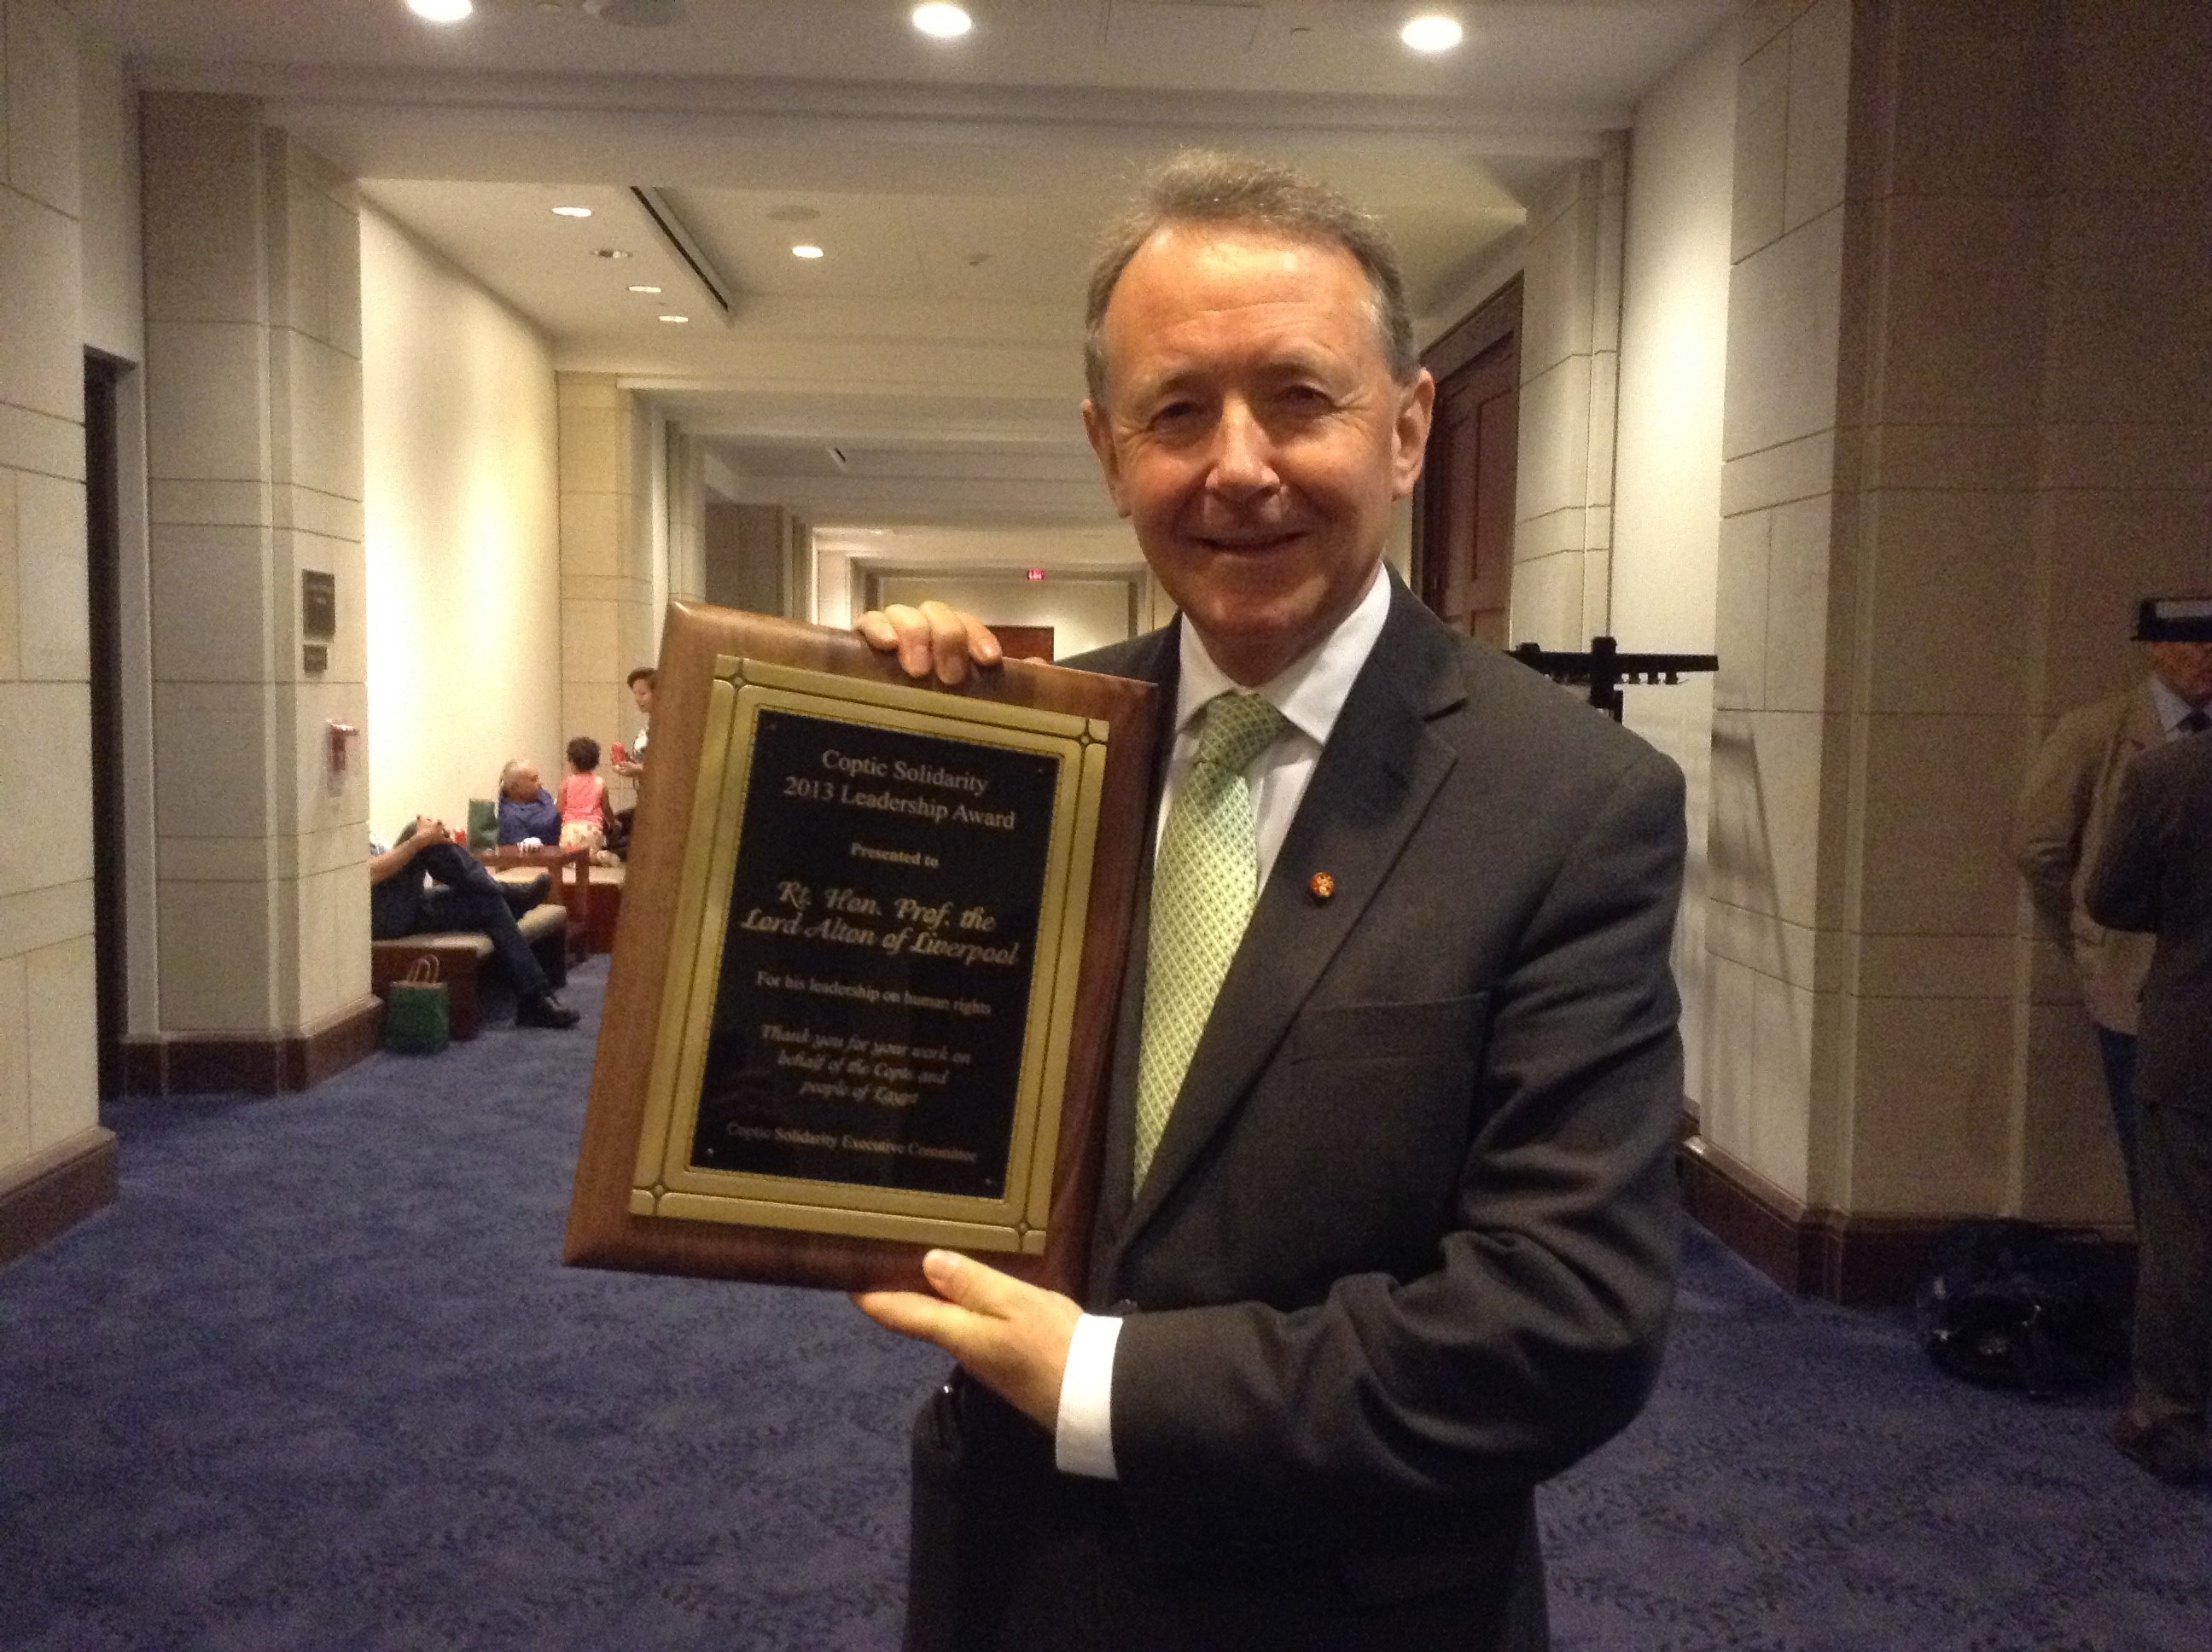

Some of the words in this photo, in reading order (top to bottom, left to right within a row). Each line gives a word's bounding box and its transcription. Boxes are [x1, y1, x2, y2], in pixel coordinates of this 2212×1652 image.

[822, 749, 888, 777] Coptic
[894, 760, 988, 796] Solidarity
[783, 776, 835, 801] 2013
[841, 784, 948, 822] Leadership
[952, 804, 1016, 830] Award
[851, 842, 922, 866] Presented
[740, 907, 803, 935] Lord
[804, 917, 876, 945] Alton
[894, 898, 954, 931] Prof.
[960, 906, 996, 932] the
[757, 970, 781, 988] For
[809, 979, 881, 1003] leadership
